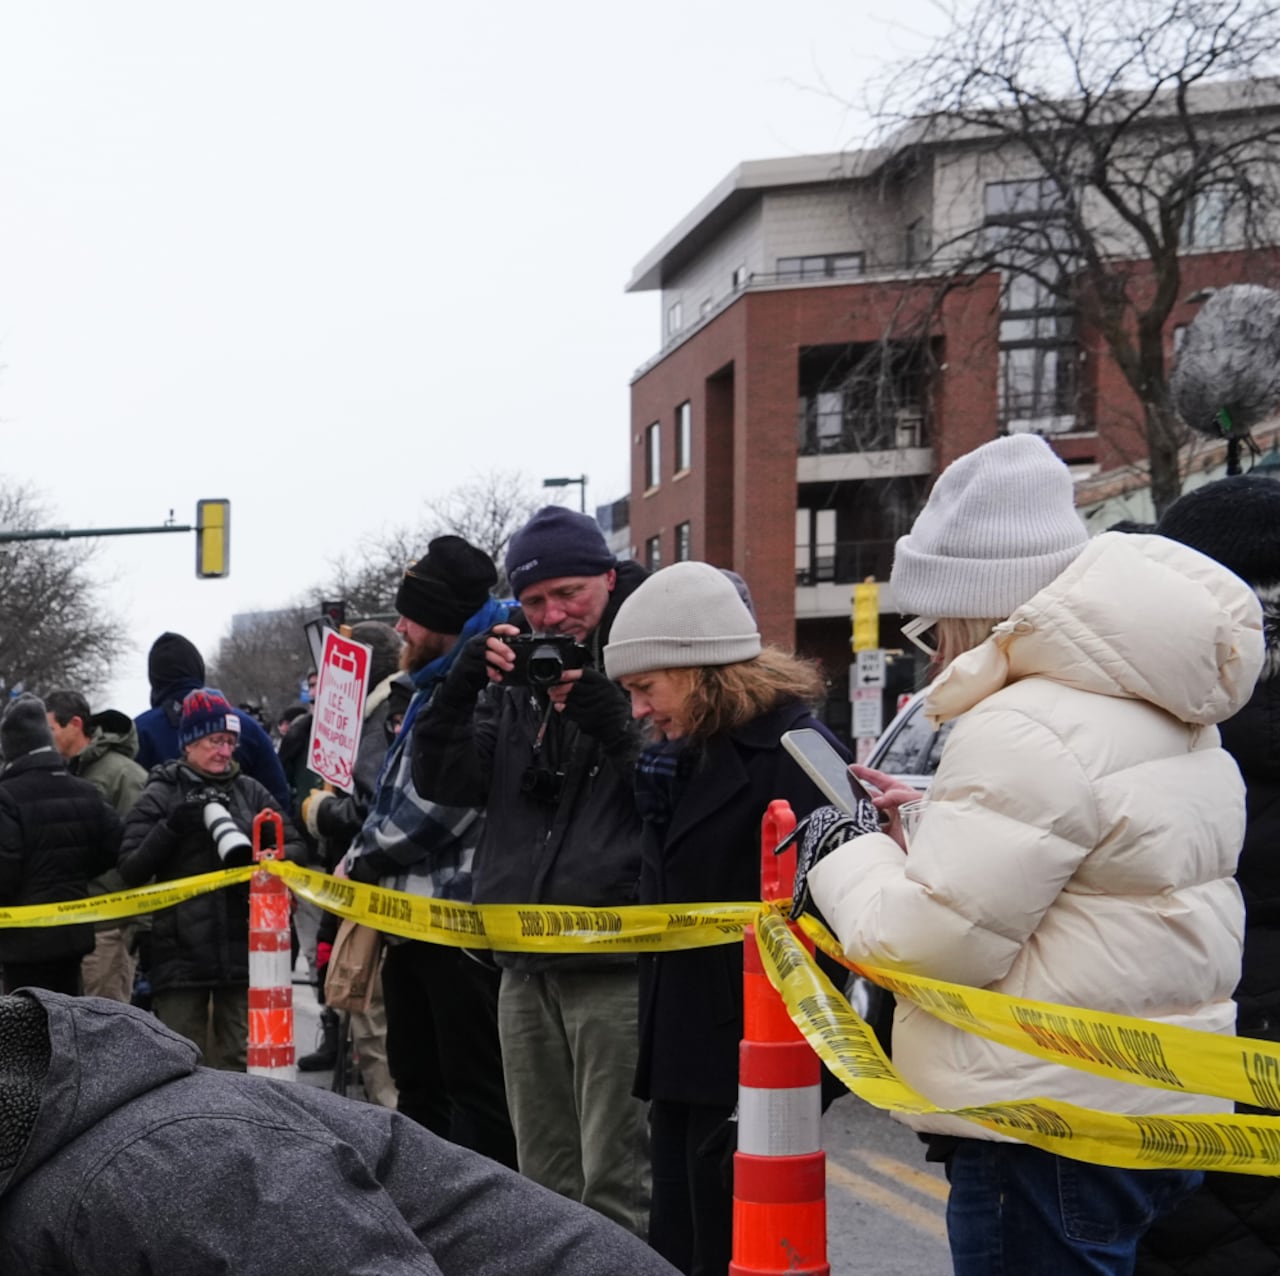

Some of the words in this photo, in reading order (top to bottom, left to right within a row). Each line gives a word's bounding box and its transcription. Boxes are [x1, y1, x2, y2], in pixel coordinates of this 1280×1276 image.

[324, 707, 336, 724] OUT
[336, 714, 349, 731] OF
[518, 910, 544, 936] CROSS
[573, 911, 594, 934] LINE
[594, 911, 622, 934] POLICE
